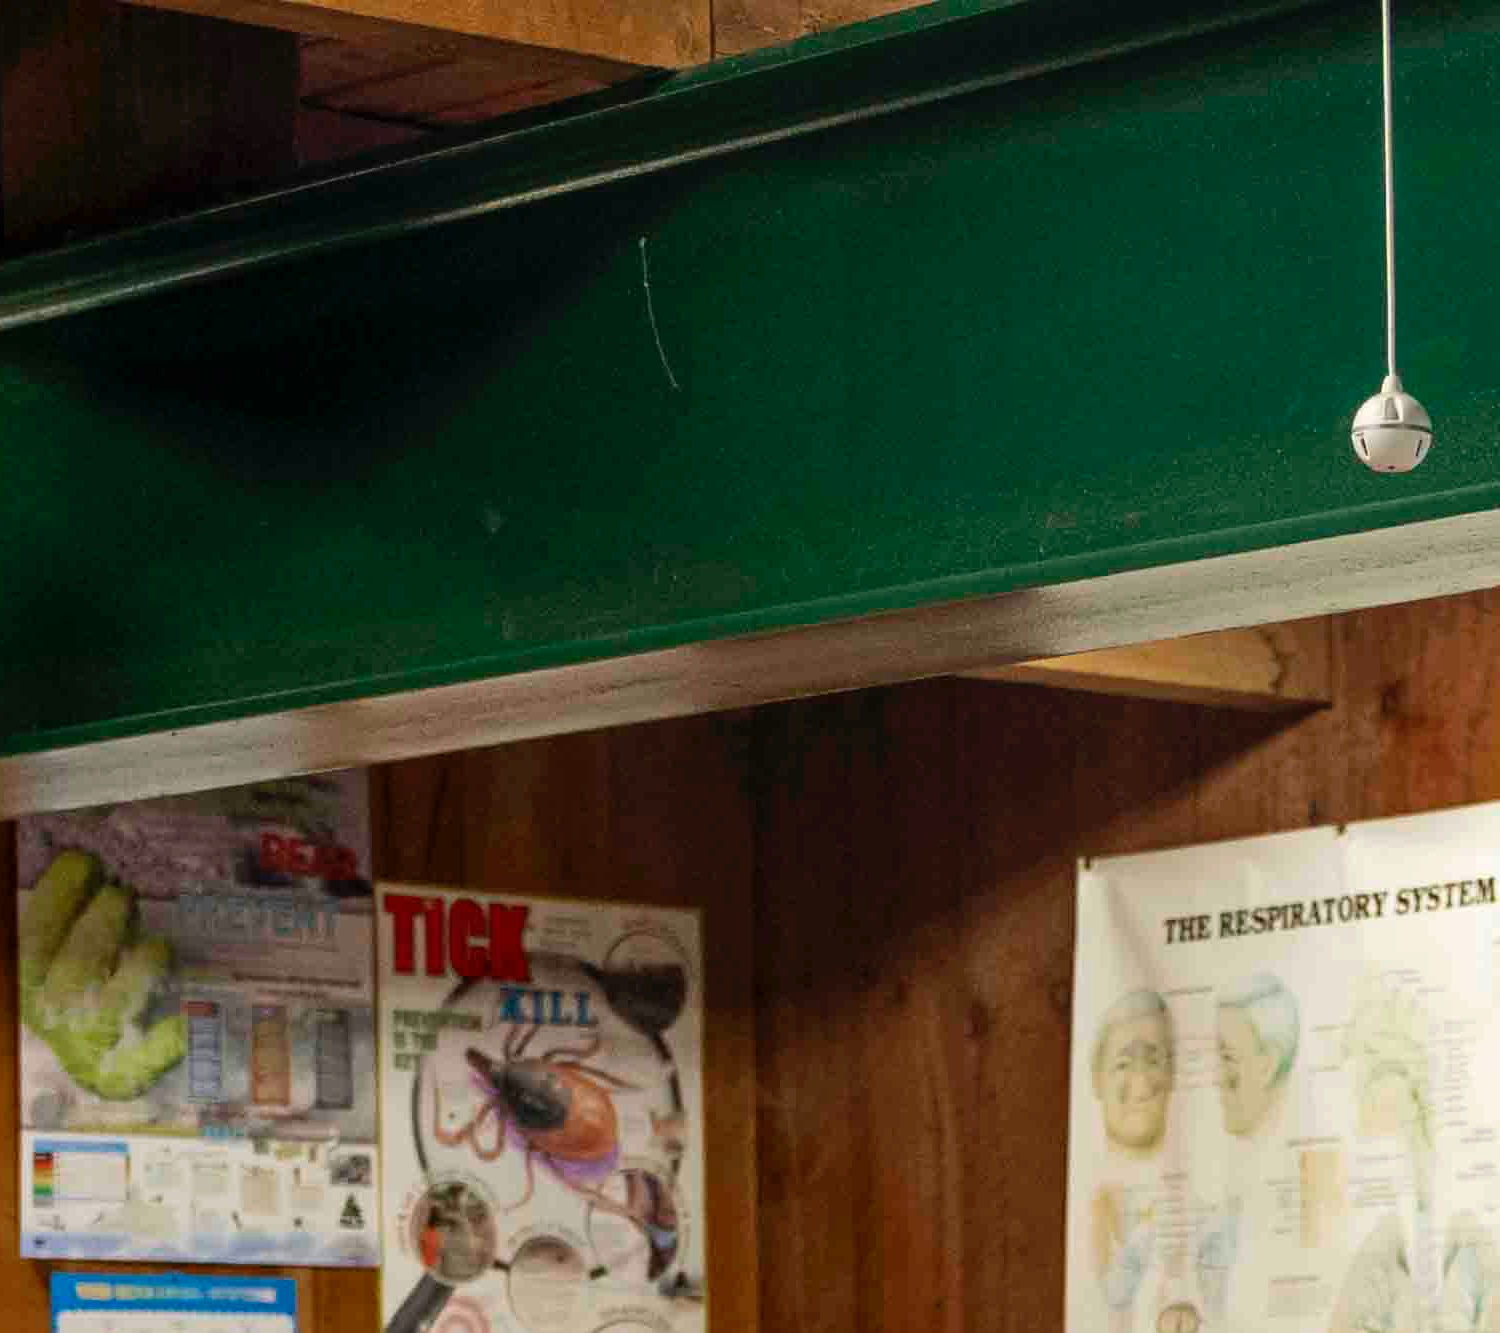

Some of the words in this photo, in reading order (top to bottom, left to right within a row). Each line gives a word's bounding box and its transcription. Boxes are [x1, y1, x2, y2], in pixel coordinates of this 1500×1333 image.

[383, 894, 533, 983] TICK
[1163, 914, 1212, 945] THE
[1219, 890, 1389, 940] RESPIRATORY
[1395, 876, 1498, 916] SYSTEM
